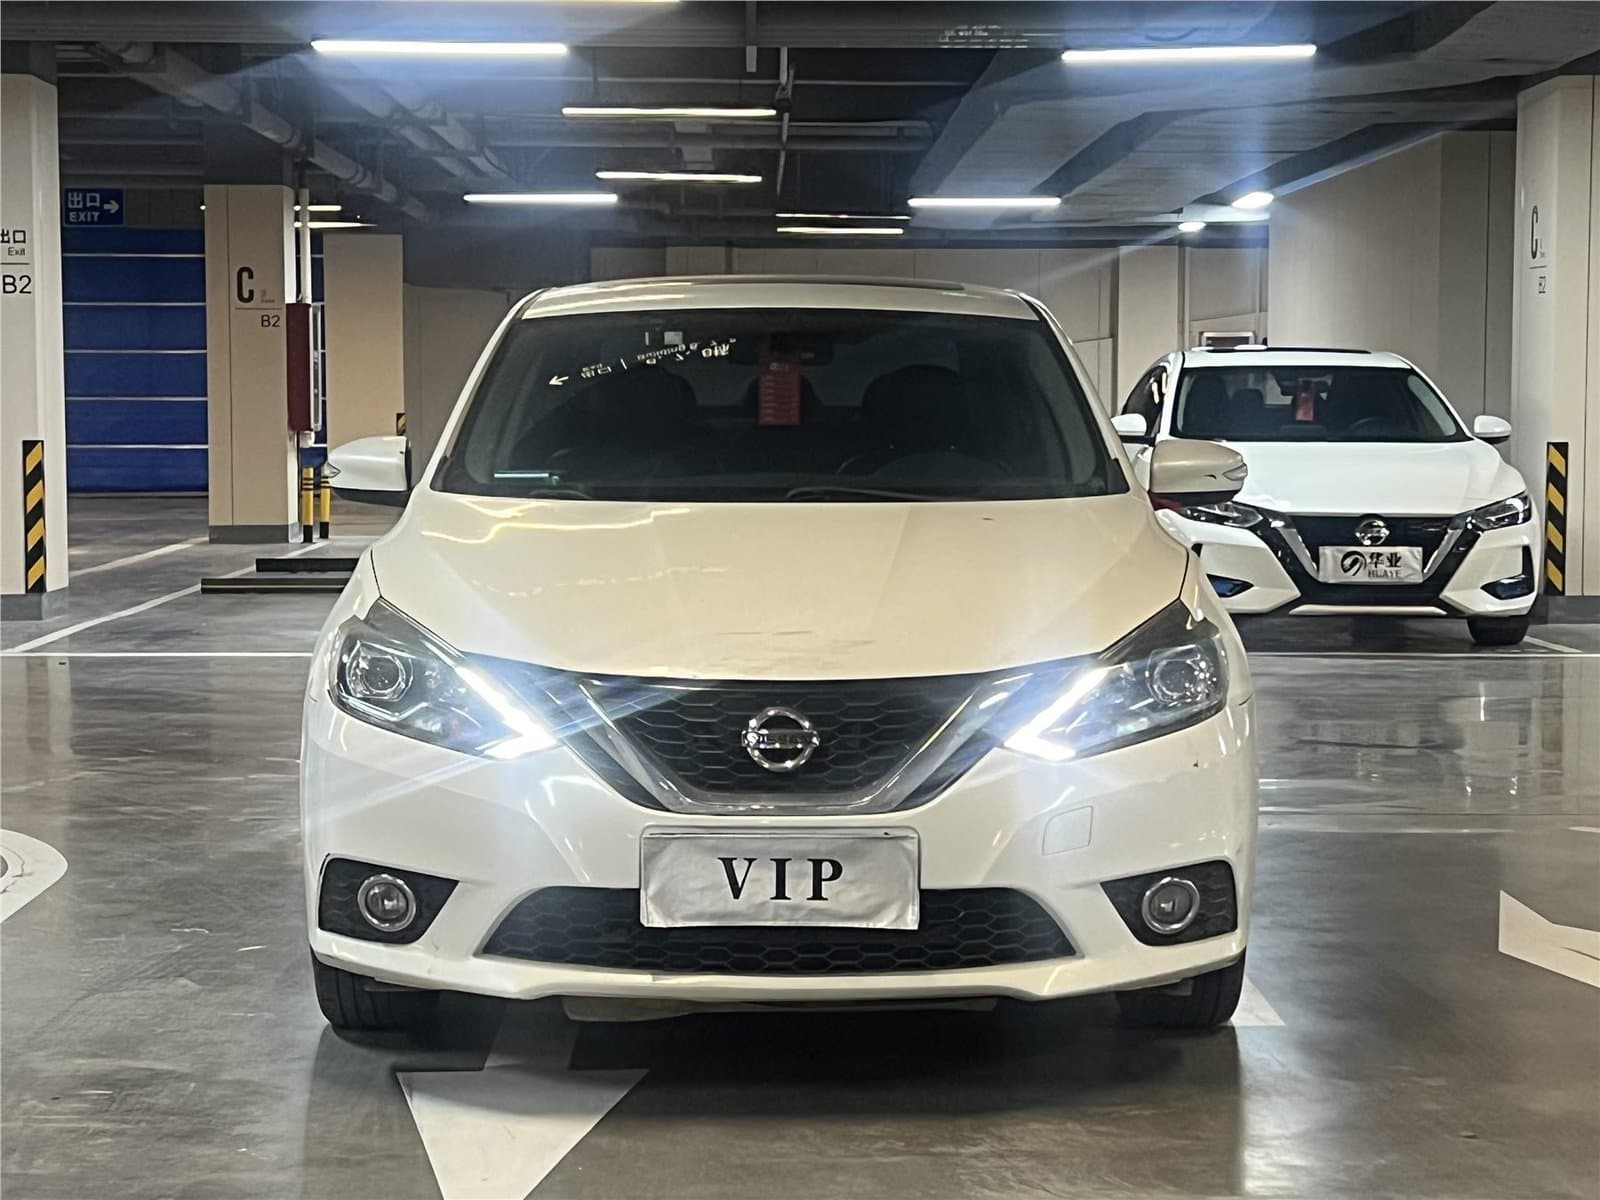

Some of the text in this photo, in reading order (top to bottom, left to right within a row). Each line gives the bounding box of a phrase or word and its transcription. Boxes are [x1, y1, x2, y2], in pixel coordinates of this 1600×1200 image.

[68, 191, 100, 208] 出口
[69, 211, 100, 222] EXIT
[1531, 204, 1539, 260] C
[2, 274, 33, 294] B2
[236, 266, 254, 303] C
[261, 314, 281, 328] B2
[1368, 551, 1402, 568] 华业
[717, 857, 844, 901] VIP
